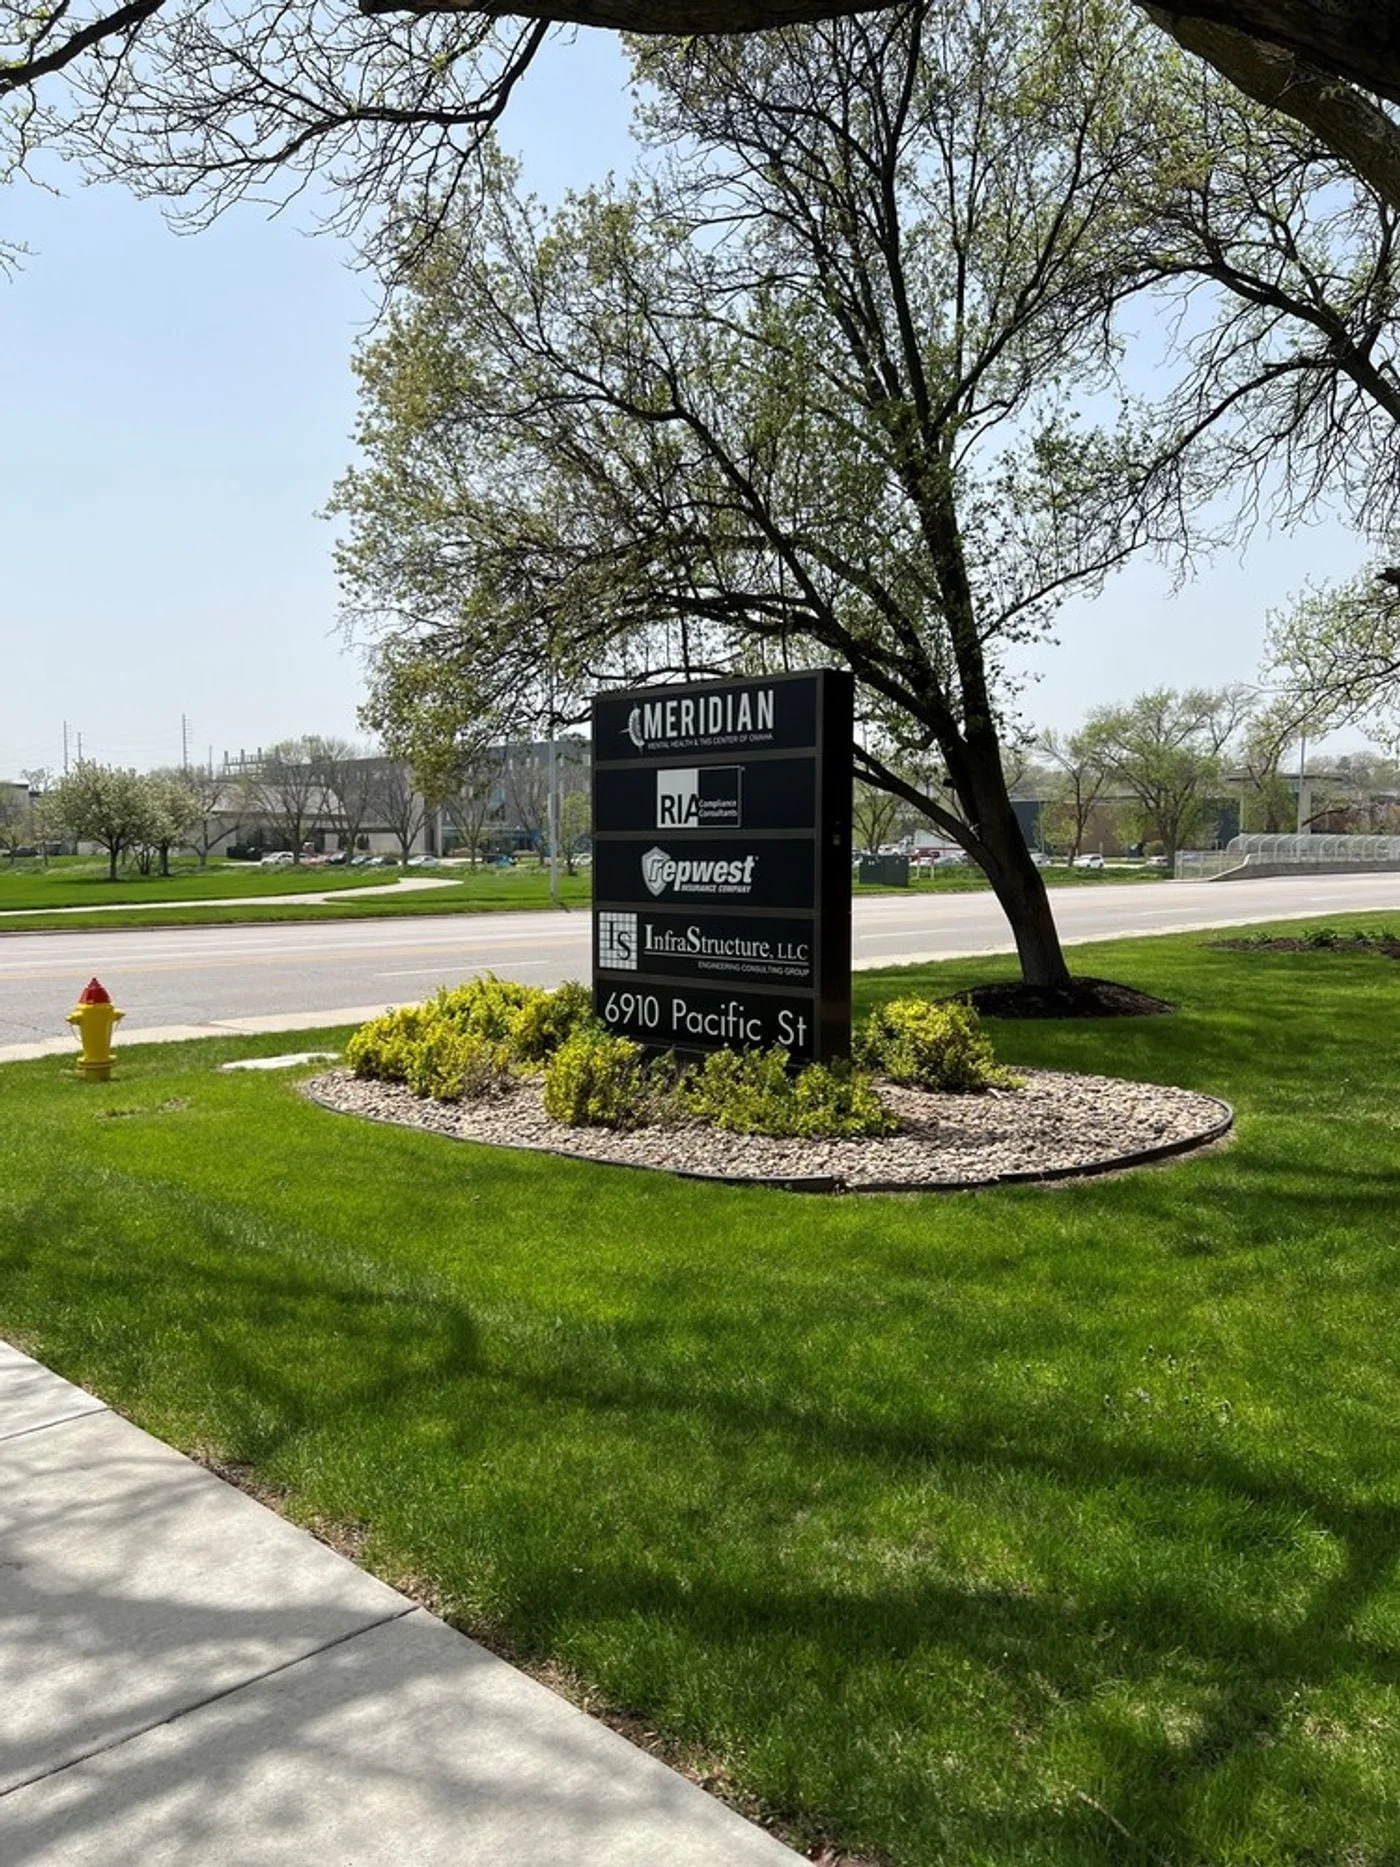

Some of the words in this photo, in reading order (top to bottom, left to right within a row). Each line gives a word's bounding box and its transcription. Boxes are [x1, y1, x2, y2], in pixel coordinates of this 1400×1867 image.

[644, 690, 774, 740] MERIDIAN
[660, 793, 700, 824] RIA
[699, 799, 737, 809] Compliance
[699, 808, 738, 817] Consultants
[650, 855, 755, 892] repwest
[777, 943, 809, 961] LLC
[784, 967, 810, 976] GROUP
[604, 992, 660, 1028] 6910
[671, 999, 763, 1041] Pacific
[778, 1010, 807, 1046] St
